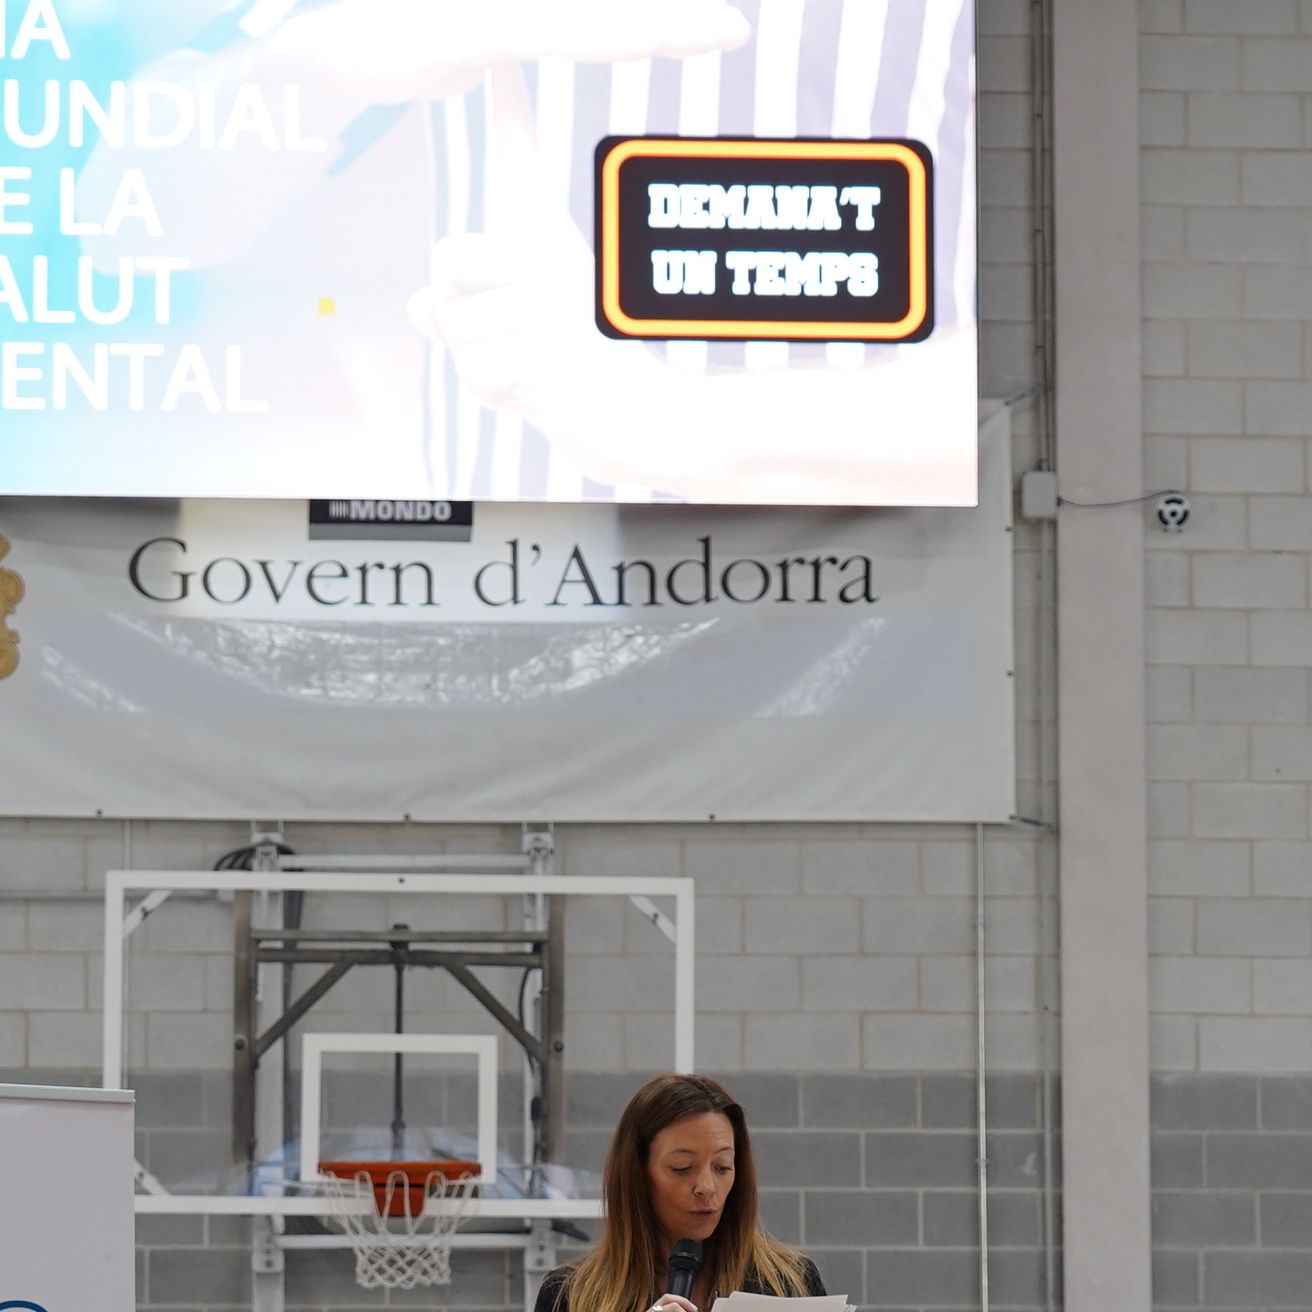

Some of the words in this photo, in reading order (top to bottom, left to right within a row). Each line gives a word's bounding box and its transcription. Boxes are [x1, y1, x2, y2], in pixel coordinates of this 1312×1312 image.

[59, 167, 163, 237] LA
[647, 183, 881, 231] DEMANA'T
[650, 249, 717, 295] UN
[725, 250, 879, 297] TEMPS
[349, 500, 452, 521] MONDO
[128, 536, 436, 607] Govern
[473, 535, 881, 608] d'Andorra
